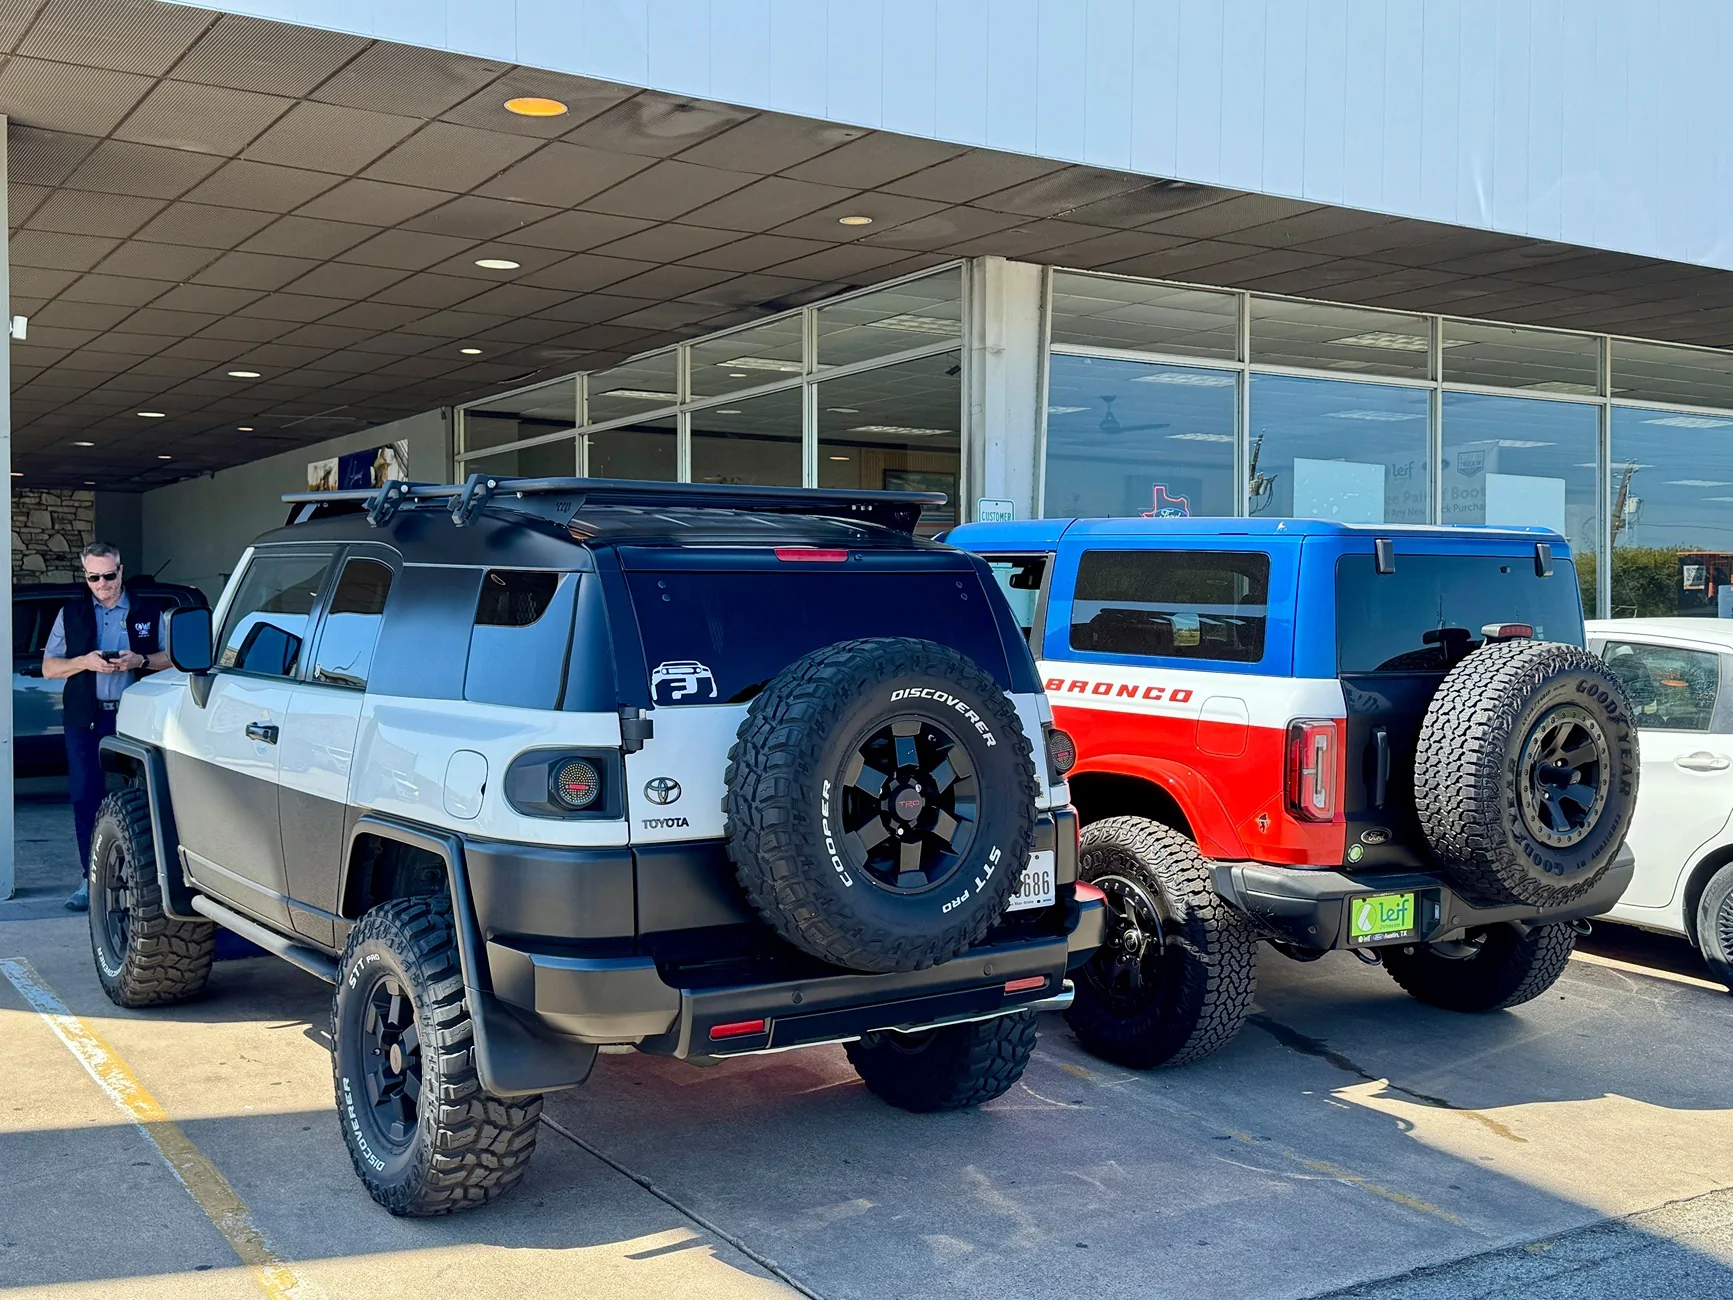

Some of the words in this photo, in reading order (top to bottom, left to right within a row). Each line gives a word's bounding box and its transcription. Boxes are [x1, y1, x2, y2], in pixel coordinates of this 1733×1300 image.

[1451, 486, 1486, 500] Boot
[981, 511, 1012, 521] CUSTOMER
[1453, 503, 1486, 512] Purcha
[1045, 678, 1193, 703] BRONCO
[890, 687, 997, 747] DISCOVERER
[899, 800, 920, 808] TRD
[642, 817, 689, 829] TOYOTA
[821, 779, 854, 888] COOPER
[975, 845, 1001, 893] STT
[1015, 871, 1050, 898] 686
[942, 889, 970, 913] PRO
[1379, 899, 1409, 927] leif
[348, 956, 366, 990] STT
[366, 953, 381, 964] PRO
[342, 1077, 386, 1172] DISCOVERER
